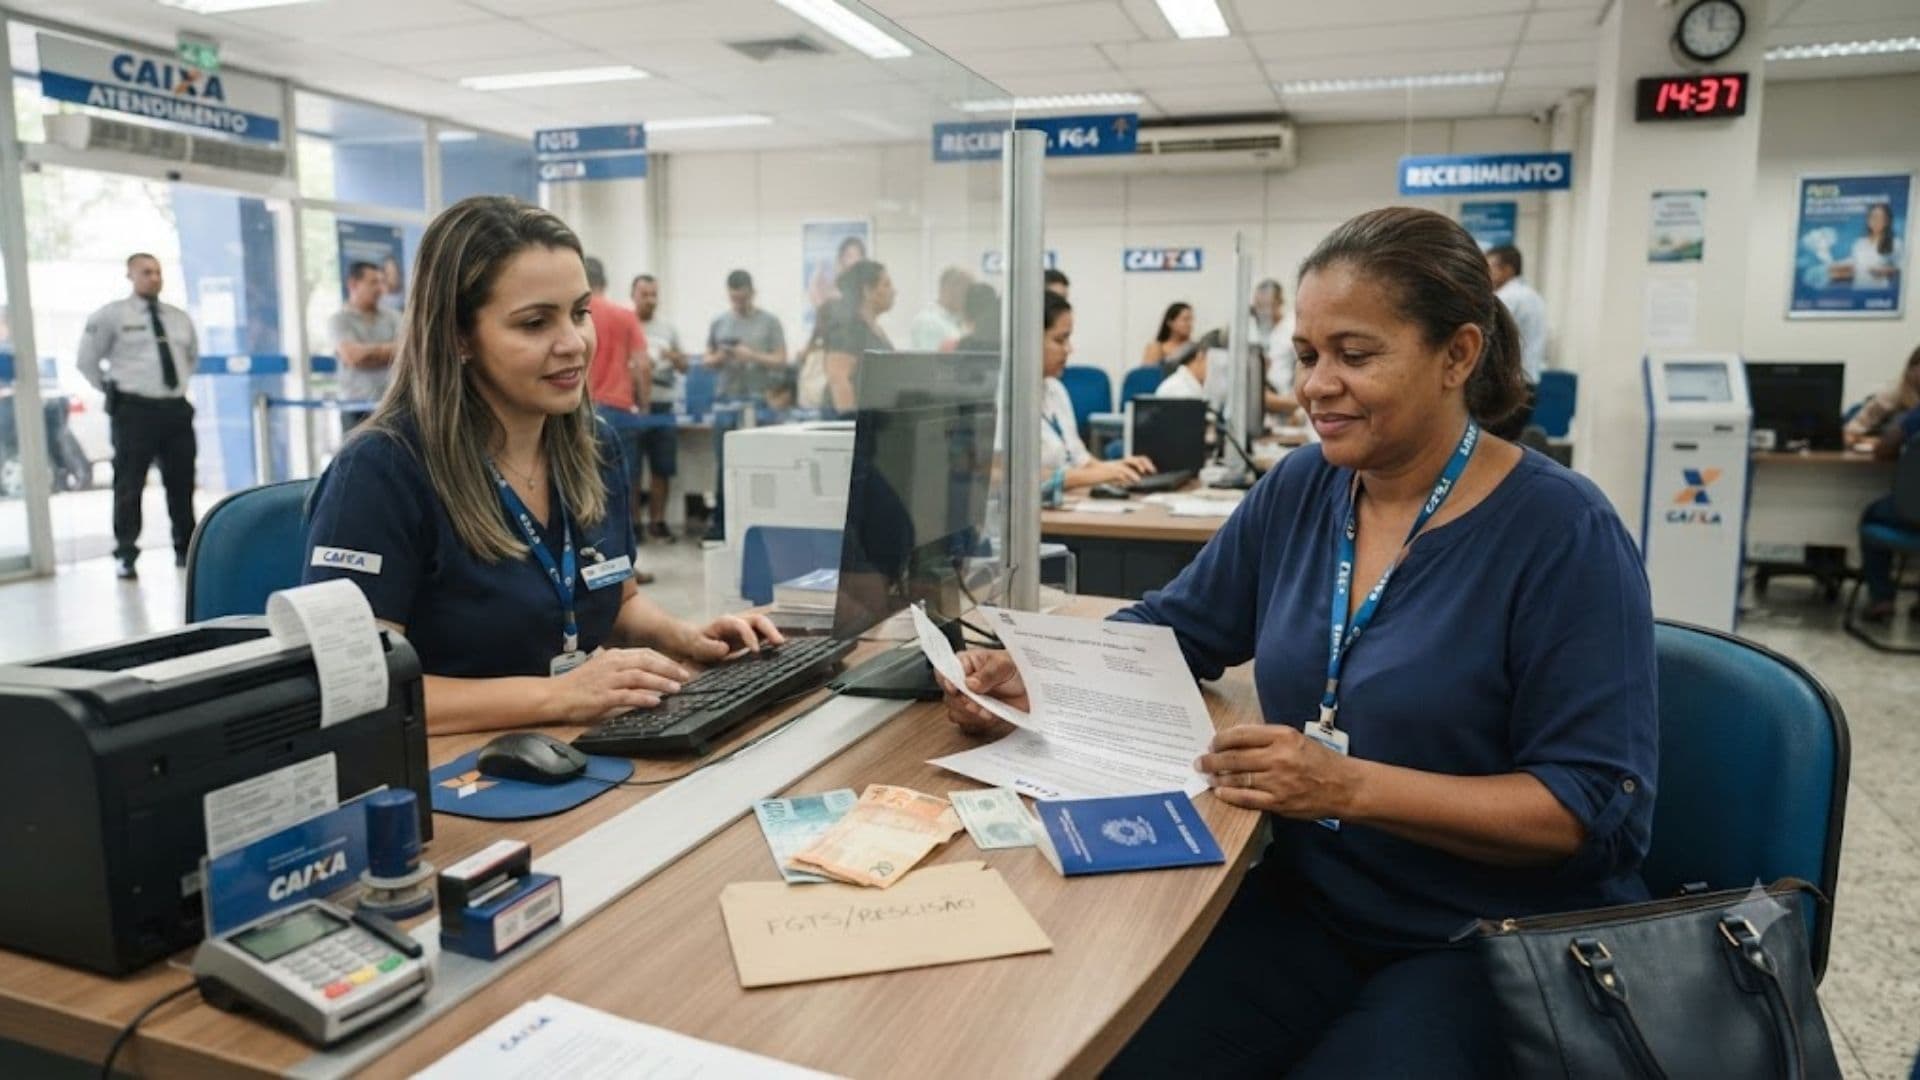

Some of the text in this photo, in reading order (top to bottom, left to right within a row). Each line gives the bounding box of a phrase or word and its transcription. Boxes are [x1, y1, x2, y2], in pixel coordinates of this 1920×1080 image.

[112, 54, 225, 101] CAIXA
[1655, 77, 1741, 113] 14:37
[87, 86, 248, 133] ATENDIMENTO
[1406, 162, 1564, 187] RECEBIMENTO
[268, 850, 347, 902] CAIXA
